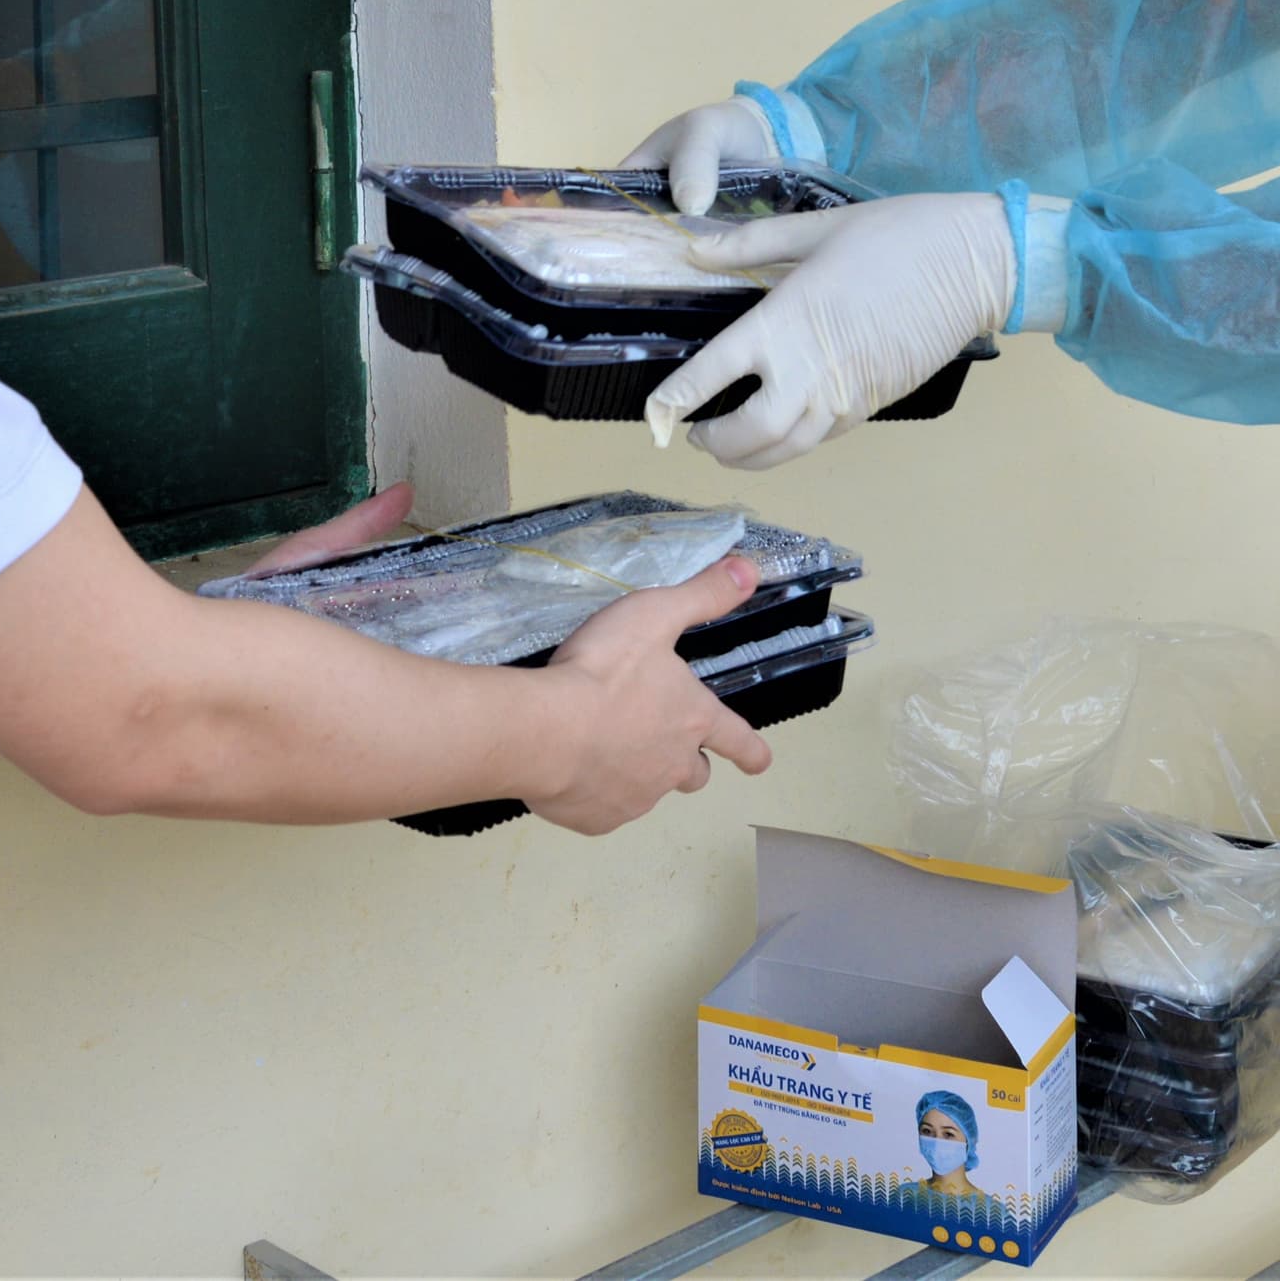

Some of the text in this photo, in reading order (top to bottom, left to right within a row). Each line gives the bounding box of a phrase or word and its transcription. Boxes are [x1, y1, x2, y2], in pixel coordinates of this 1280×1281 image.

[729, 1034, 799, 1061] DANAMECO
[728, 1063, 873, 1111] KHẨU TRANG Y TẾ
[991, 1089, 1007, 1100] 50
[833, 1118, 847, 1127] GAS
[826, 1206, 842, 1215] USA
